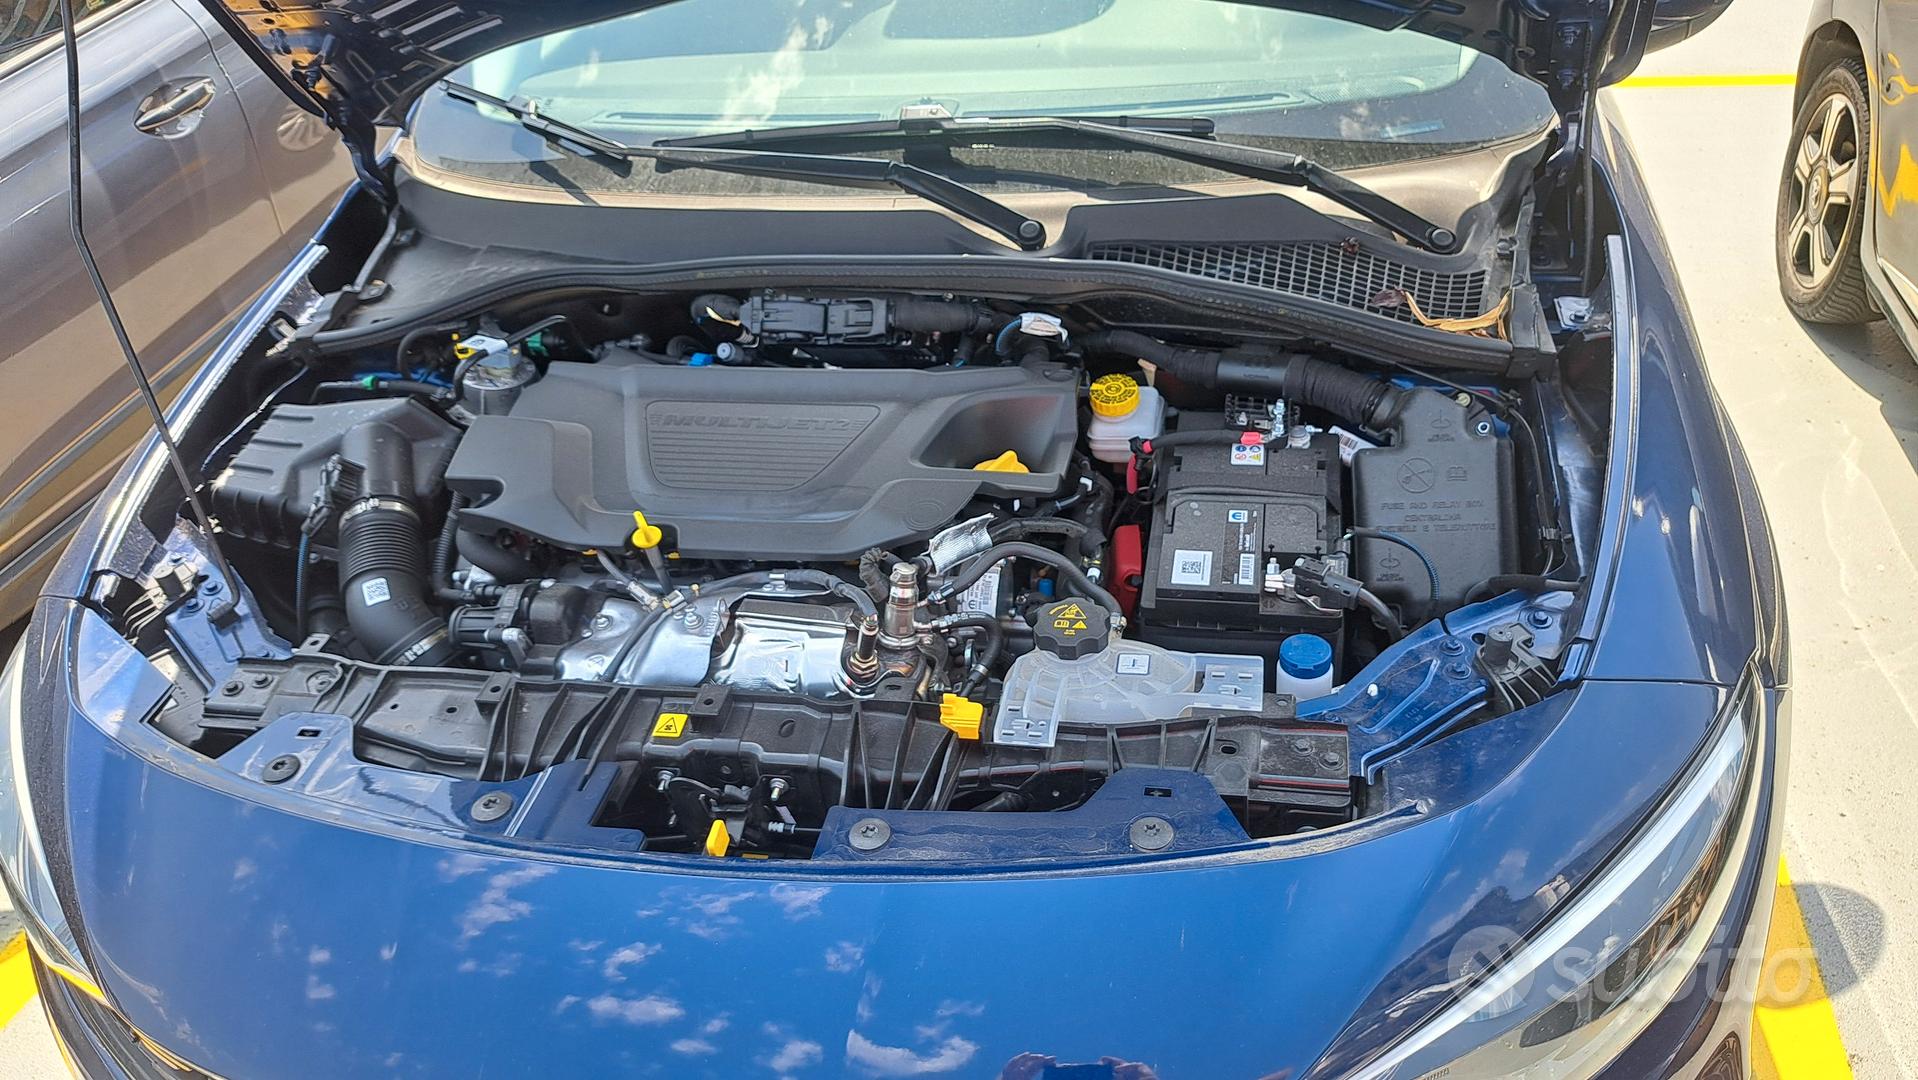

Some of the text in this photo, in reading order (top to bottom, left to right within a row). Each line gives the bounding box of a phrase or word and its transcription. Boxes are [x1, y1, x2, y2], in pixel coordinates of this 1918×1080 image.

[1380, 502, 1404, 511] FUSE
[1409, 501, 1427, 510] AND
[1431, 501, 1461, 509] RELAY
